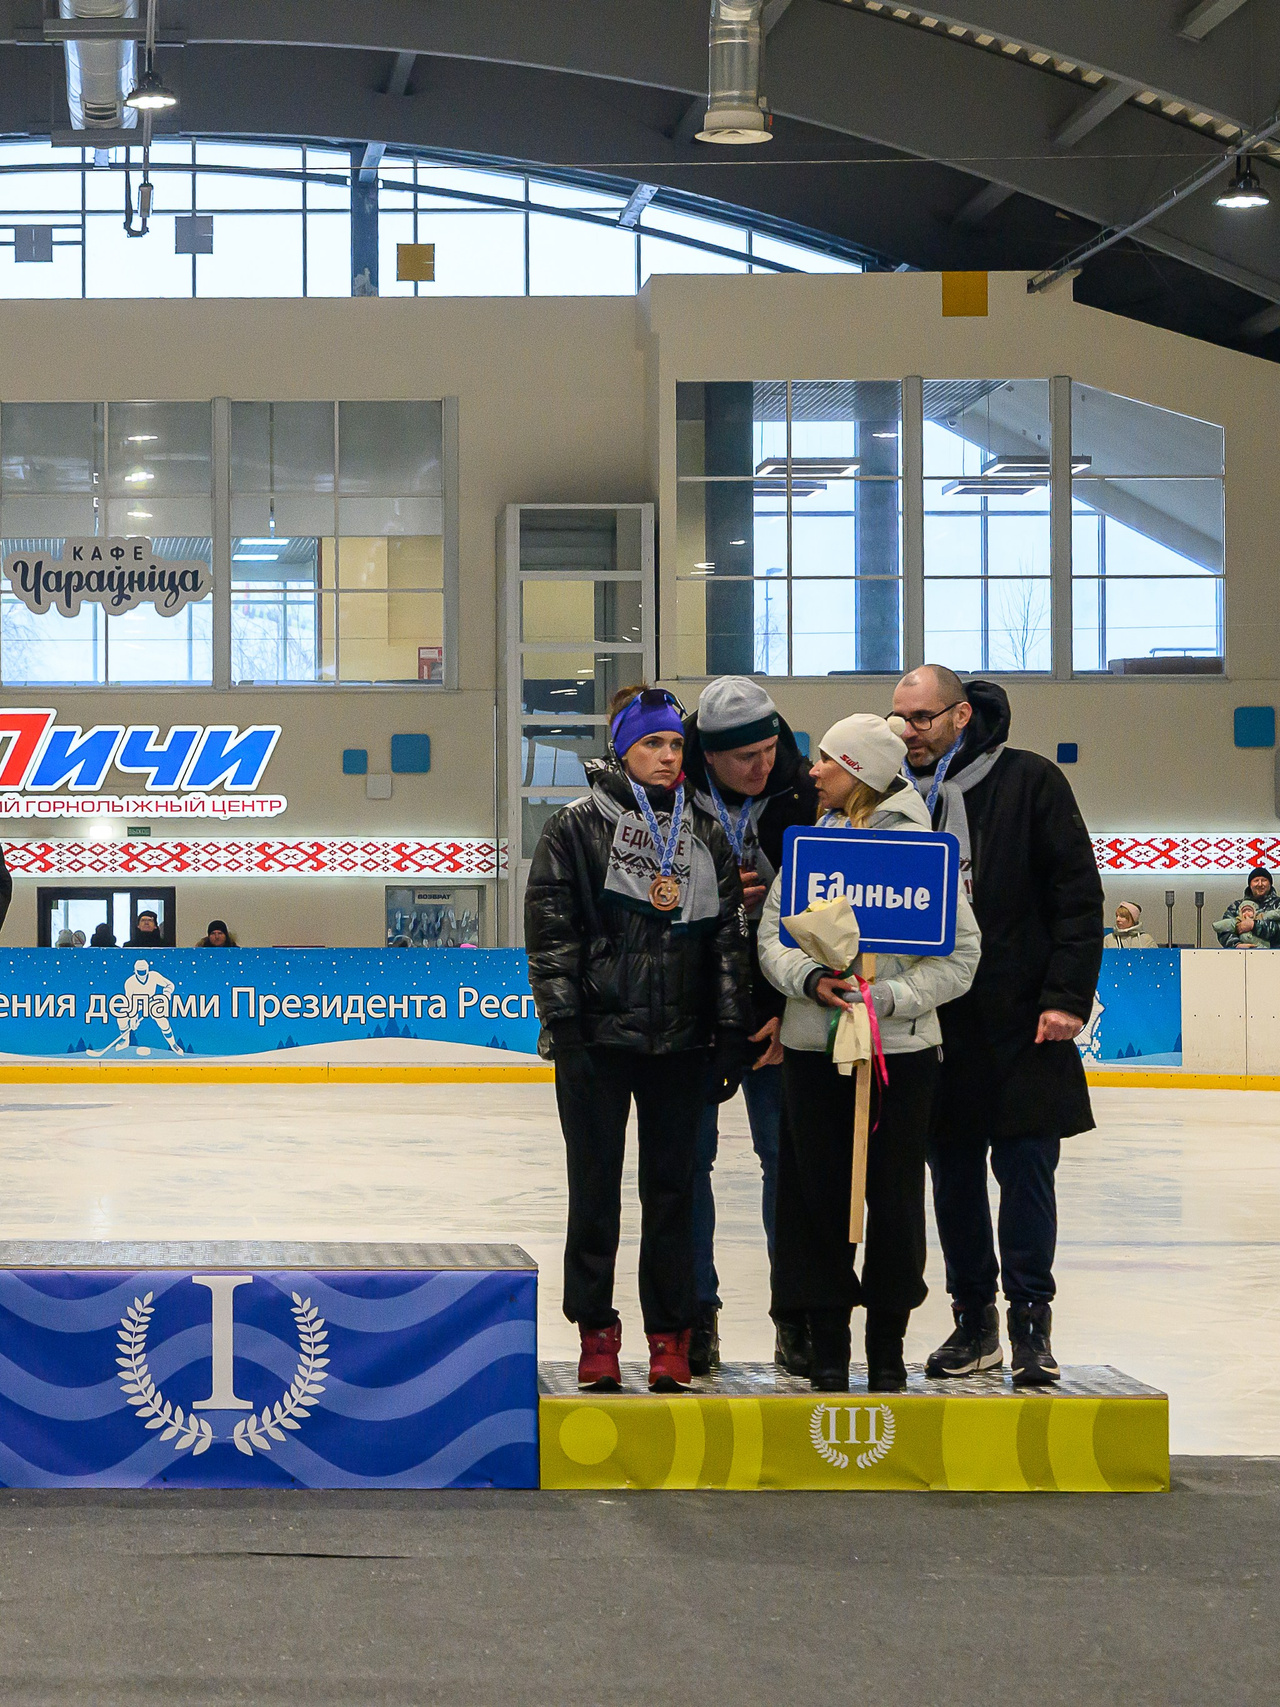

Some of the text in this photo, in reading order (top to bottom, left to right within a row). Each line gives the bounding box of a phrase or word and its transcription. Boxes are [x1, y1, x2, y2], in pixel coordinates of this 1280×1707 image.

[72, 546, 143, 561] КАФЕ
[12, 560, 204, 609] Чараўніца
[26, 796, 206, 813] ГОРНОЛЫЖНЫЙ
[212, 800, 283, 815] ЦЕНТР
[808, 871, 931, 911] Единые
[85, 994, 220, 1024] делами
[231, 986, 447, 1026] Президента
[824, 1407, 881, 1443] III
